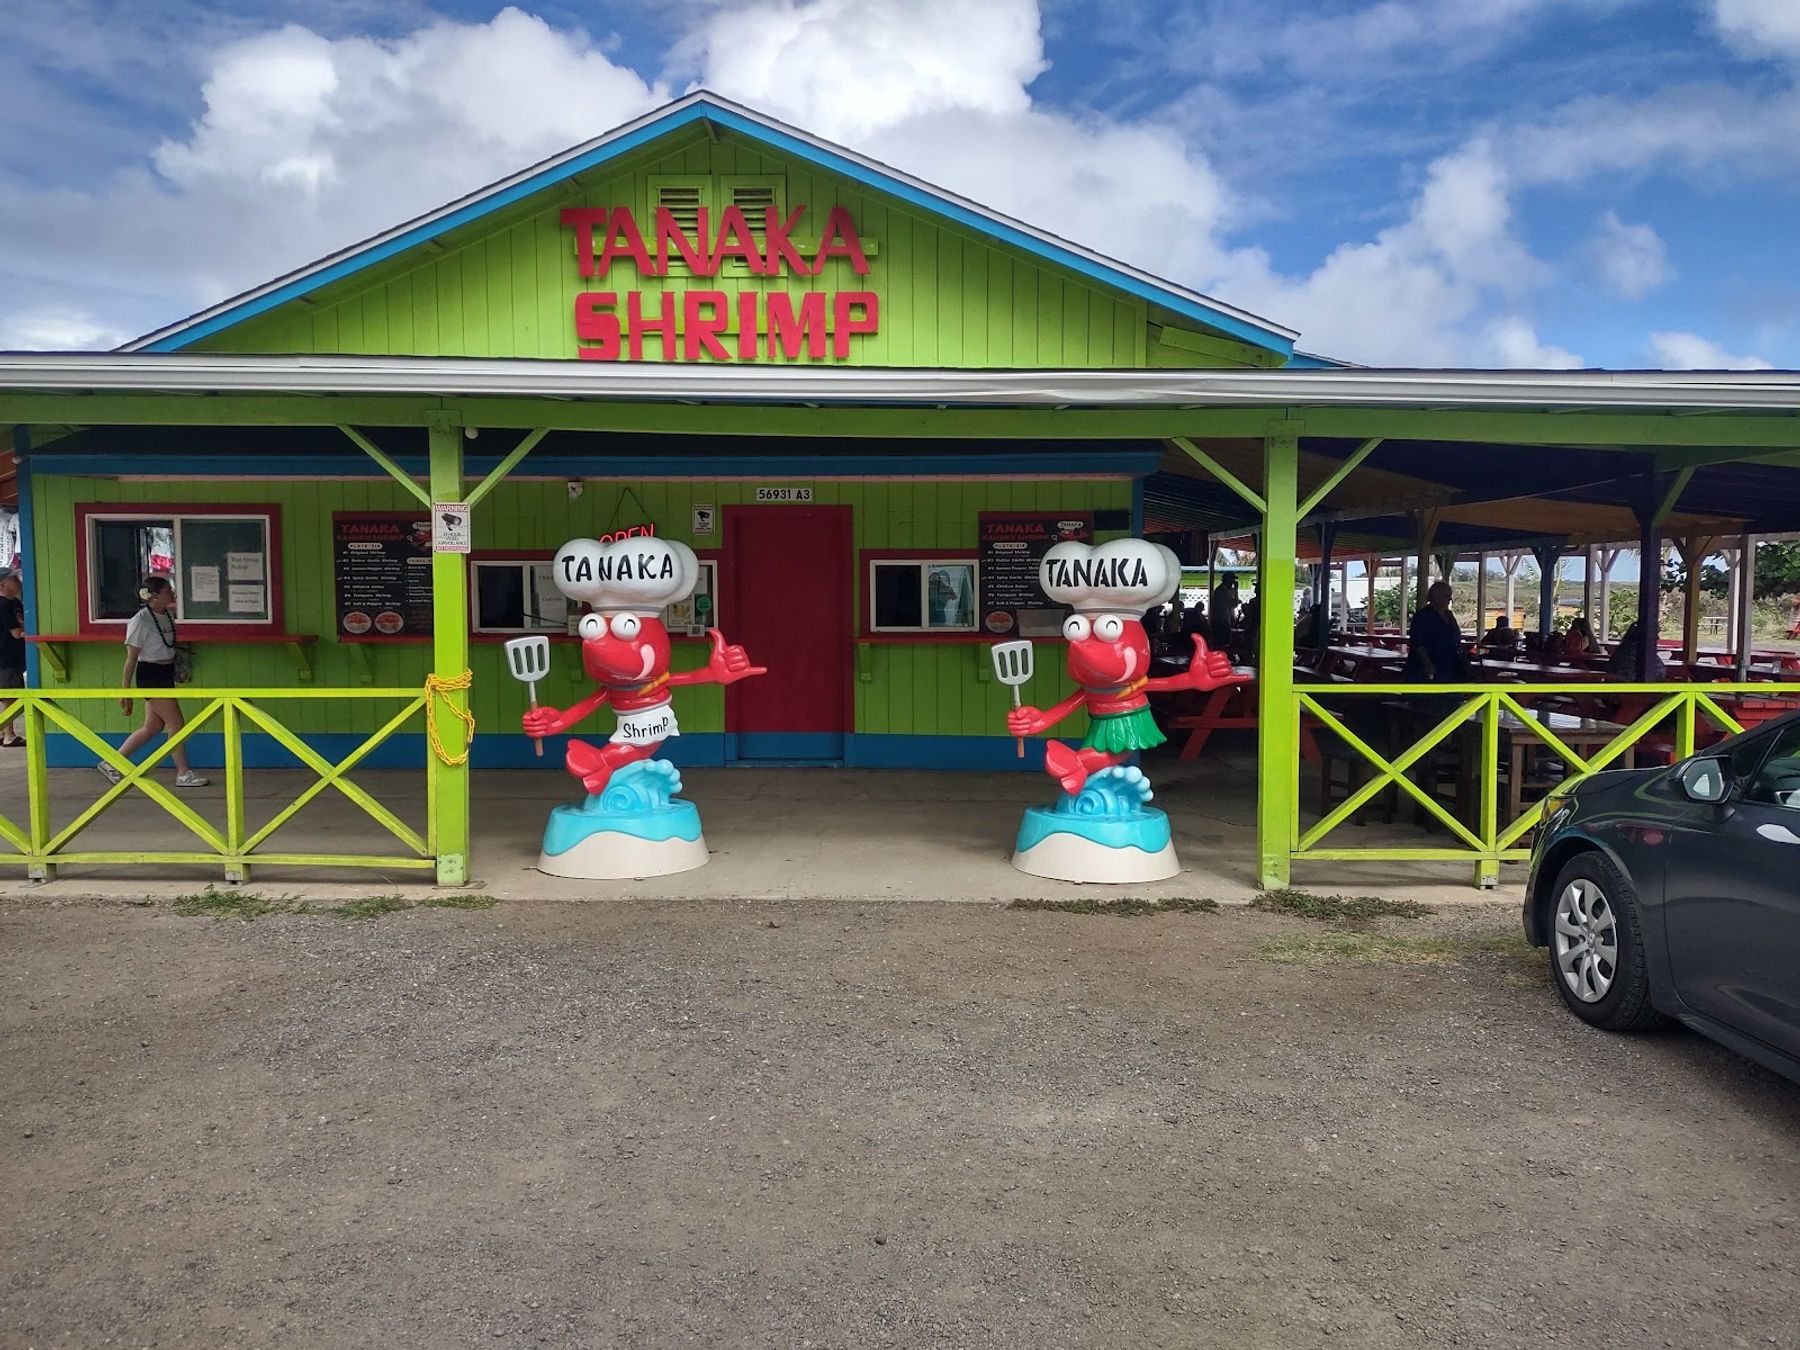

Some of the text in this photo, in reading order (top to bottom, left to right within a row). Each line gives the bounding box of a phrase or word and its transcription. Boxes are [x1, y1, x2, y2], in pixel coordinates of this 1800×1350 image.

[560, 205, 871, 277] TANAKA
[575, 291, 878, 360] SHRIMP
[759, 489, 810, 500] 56931 A3
[341, 524, 400, 534] TANAKA
[987, 524, 1046, 533] TANAKA
[562, 553, 673, 583] TANAKA
[1046, 558, 1148, 587] TANAKA
[623, 716, 669, 738] Shrimp
